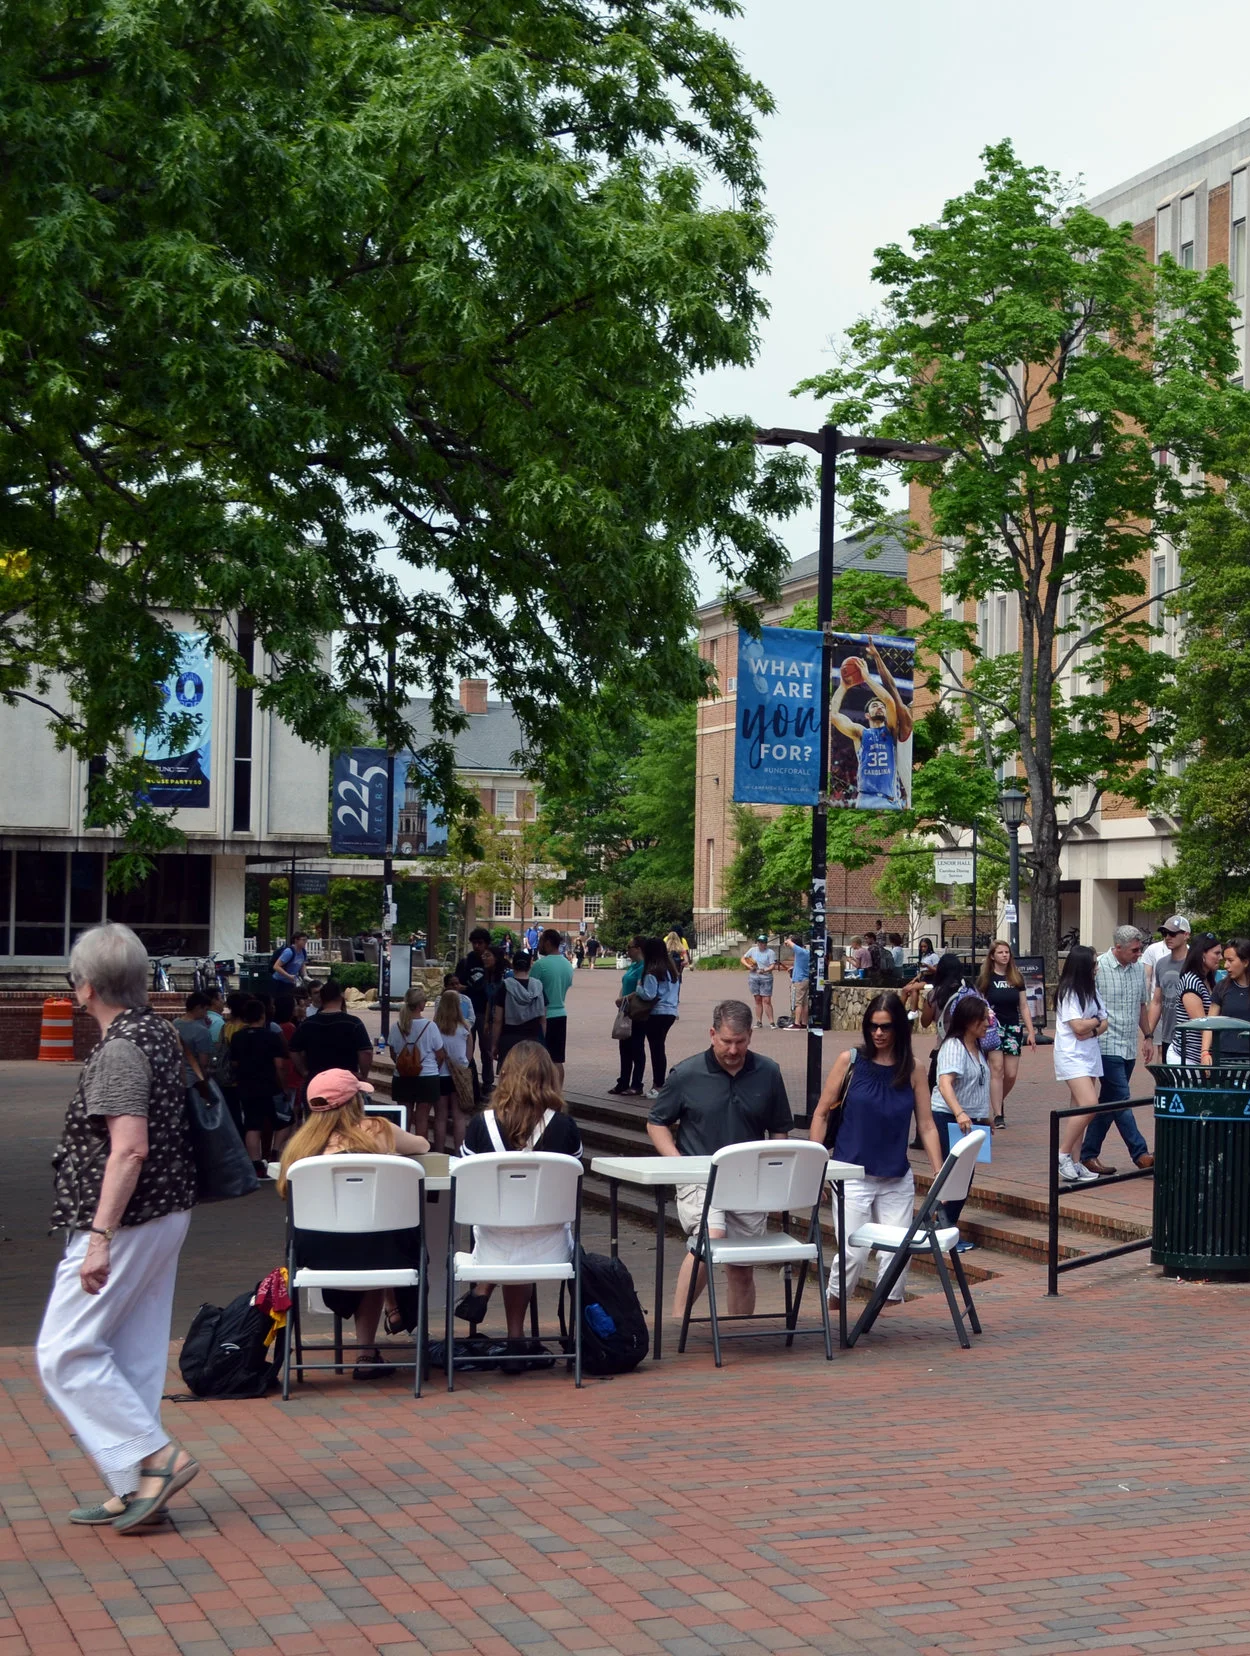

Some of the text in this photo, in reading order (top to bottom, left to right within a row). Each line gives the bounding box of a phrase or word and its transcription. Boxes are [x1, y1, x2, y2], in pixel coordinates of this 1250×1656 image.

[750, 658, 814, 678] WHAT
[772, 681, 813, 699] ARE
[742, 703, 821, 770] you
[760, 743, 812, 762] FOR?
[867, 751, 888, 767] 32
[764, 767, 810, 776] #UNCFORALL
[337, 758, 389, 834] 225
[374, 783, 384, 834] YEARS
